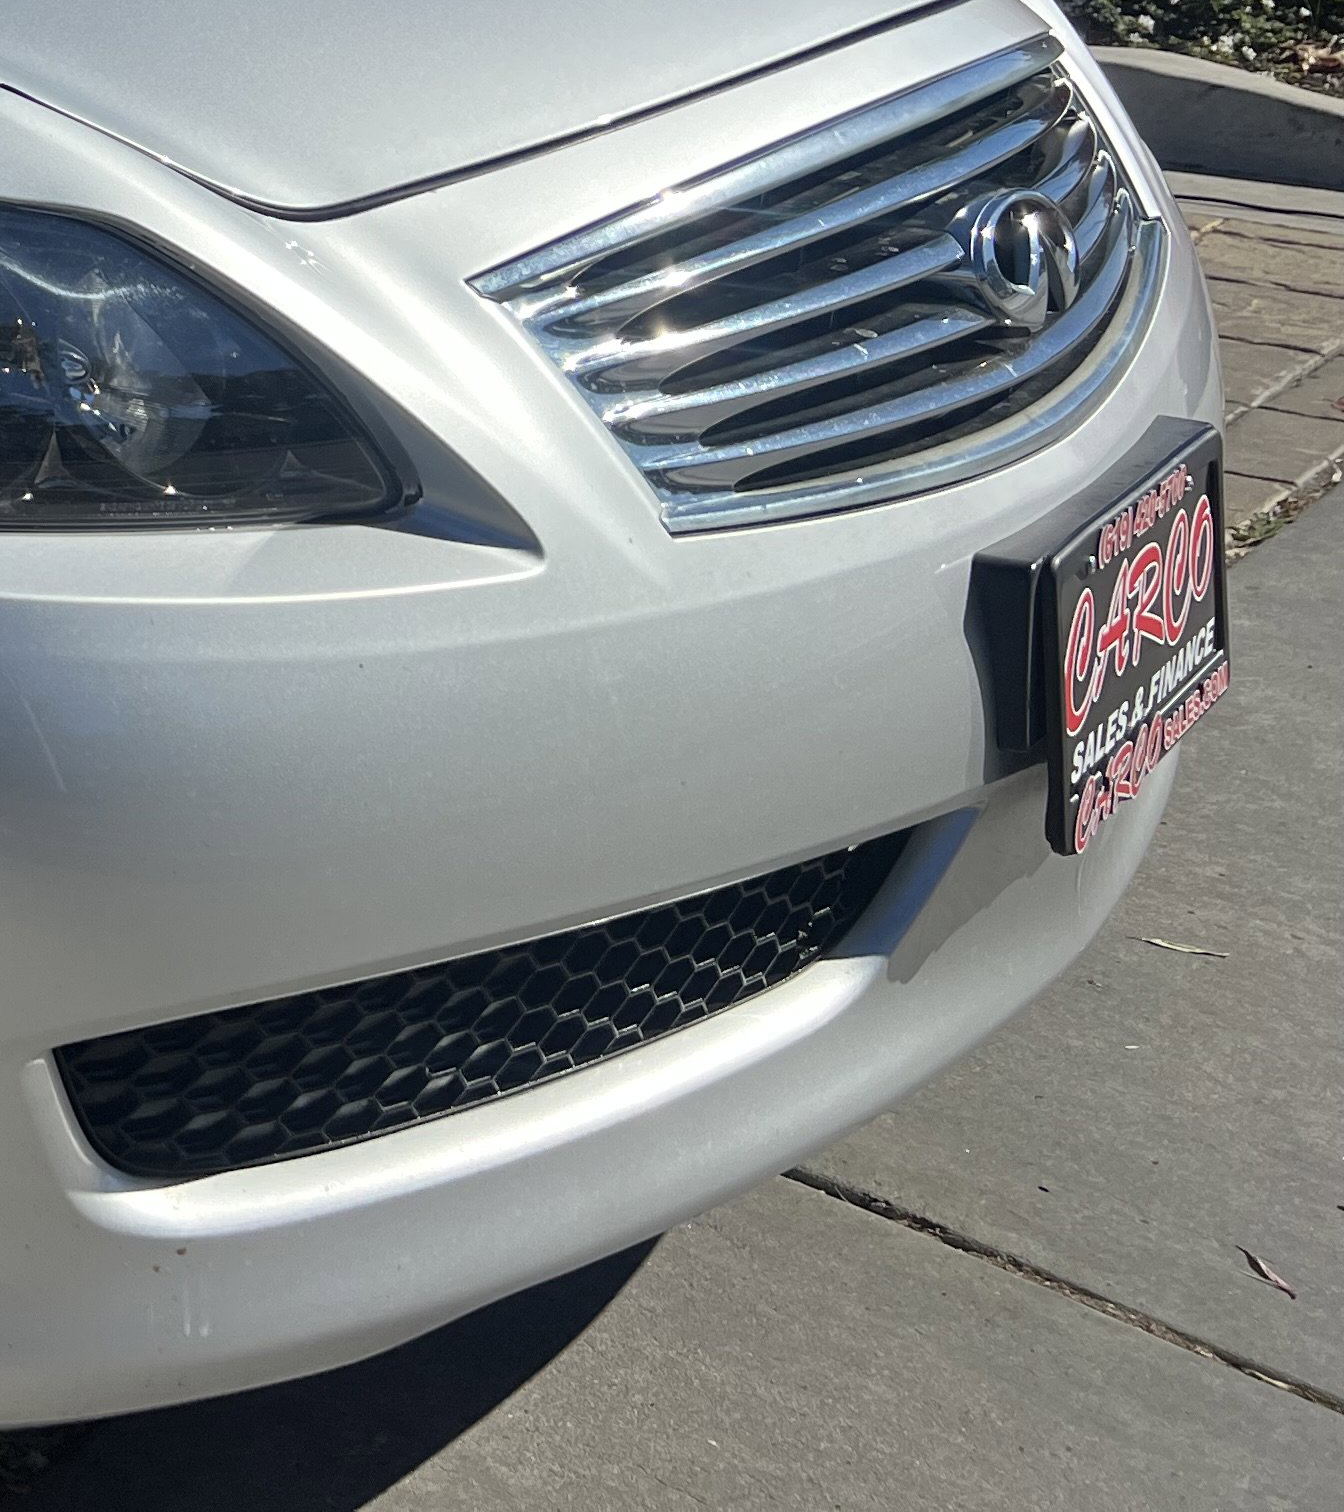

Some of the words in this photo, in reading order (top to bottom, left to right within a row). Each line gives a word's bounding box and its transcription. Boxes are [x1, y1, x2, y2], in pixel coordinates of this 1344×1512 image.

[1064, 494, 1213, 736] CARCO
[1099, 506, 1134, 570] (619)
[1070, 699, 1130, 785] SALES
[1128, 686, 1145, 728] &
[1143, 616, 1216, 717] FINANCE
